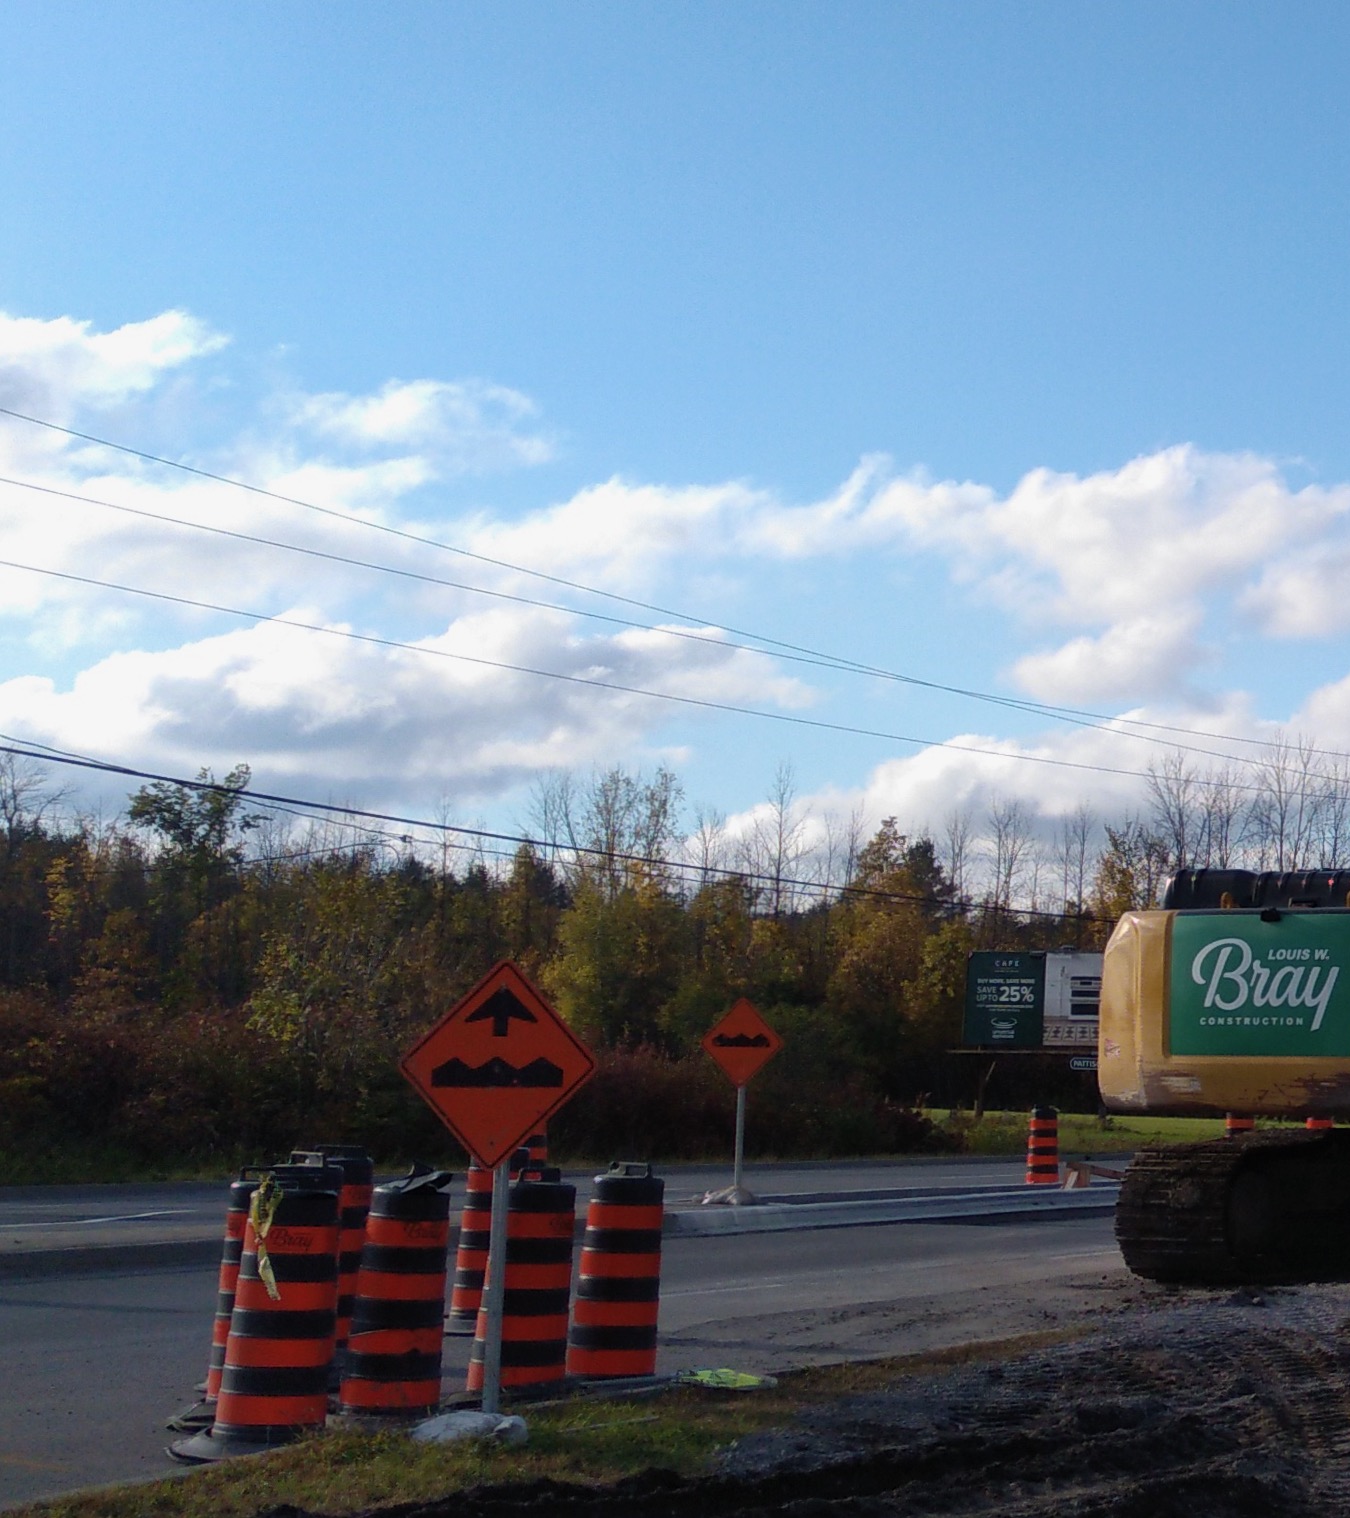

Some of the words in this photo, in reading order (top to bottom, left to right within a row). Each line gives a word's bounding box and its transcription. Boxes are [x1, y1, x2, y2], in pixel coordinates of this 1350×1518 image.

[1267, 949, 1311, 960] LOUIS
[1314, 949, 1330, 960] W.
[977, 986, 997, 994] SAVE
[1191, 937, 1340, 1032] Bray
[999, 986, 1034, 1002] 25%
[1199, 1016, 1304, 1026] CONSTRUCTION
[270, 1228, 313, 1252] Bray
